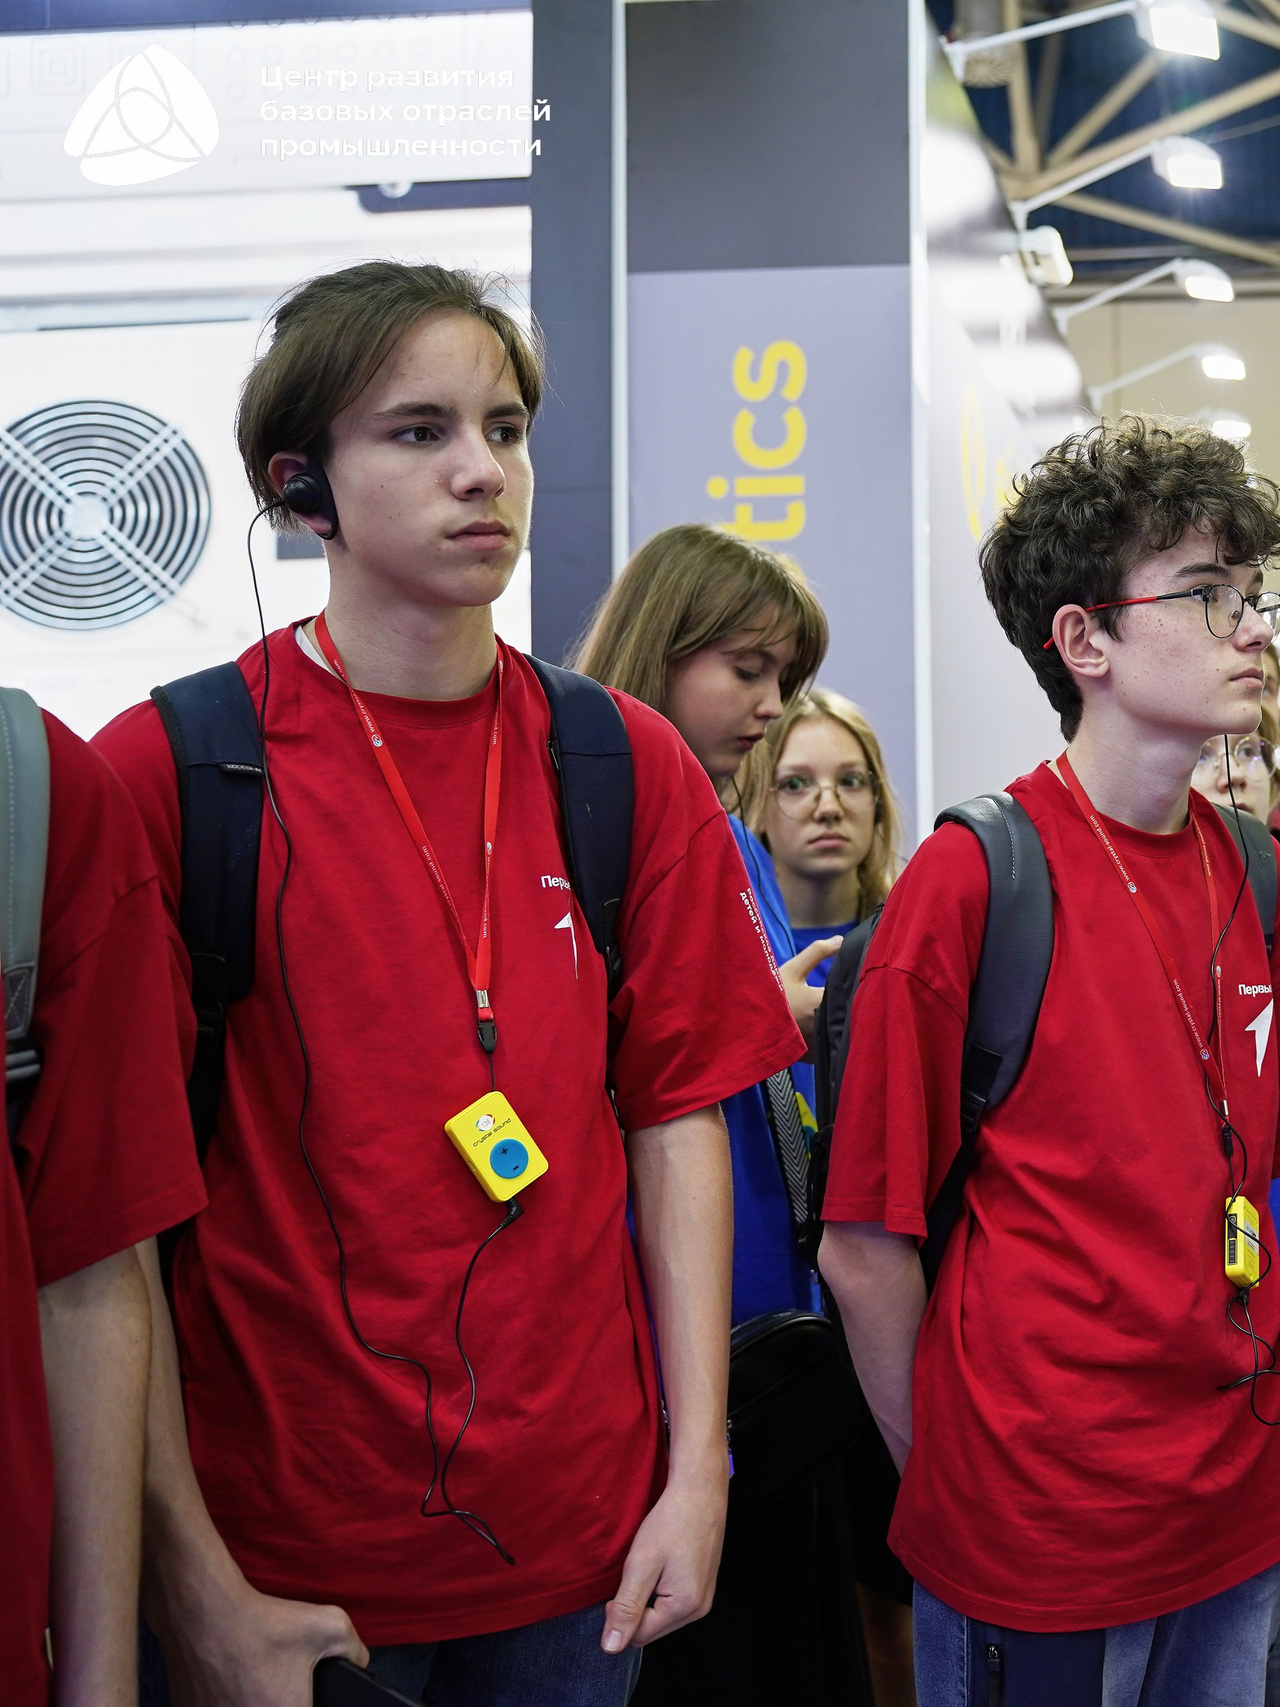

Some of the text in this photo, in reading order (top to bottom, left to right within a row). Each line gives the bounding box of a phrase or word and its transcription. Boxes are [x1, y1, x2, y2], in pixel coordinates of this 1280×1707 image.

[707, 339, 807, 560] tics
[740, 892, 757, 924] детей
[1238, 984, 1272, 998] Первы
